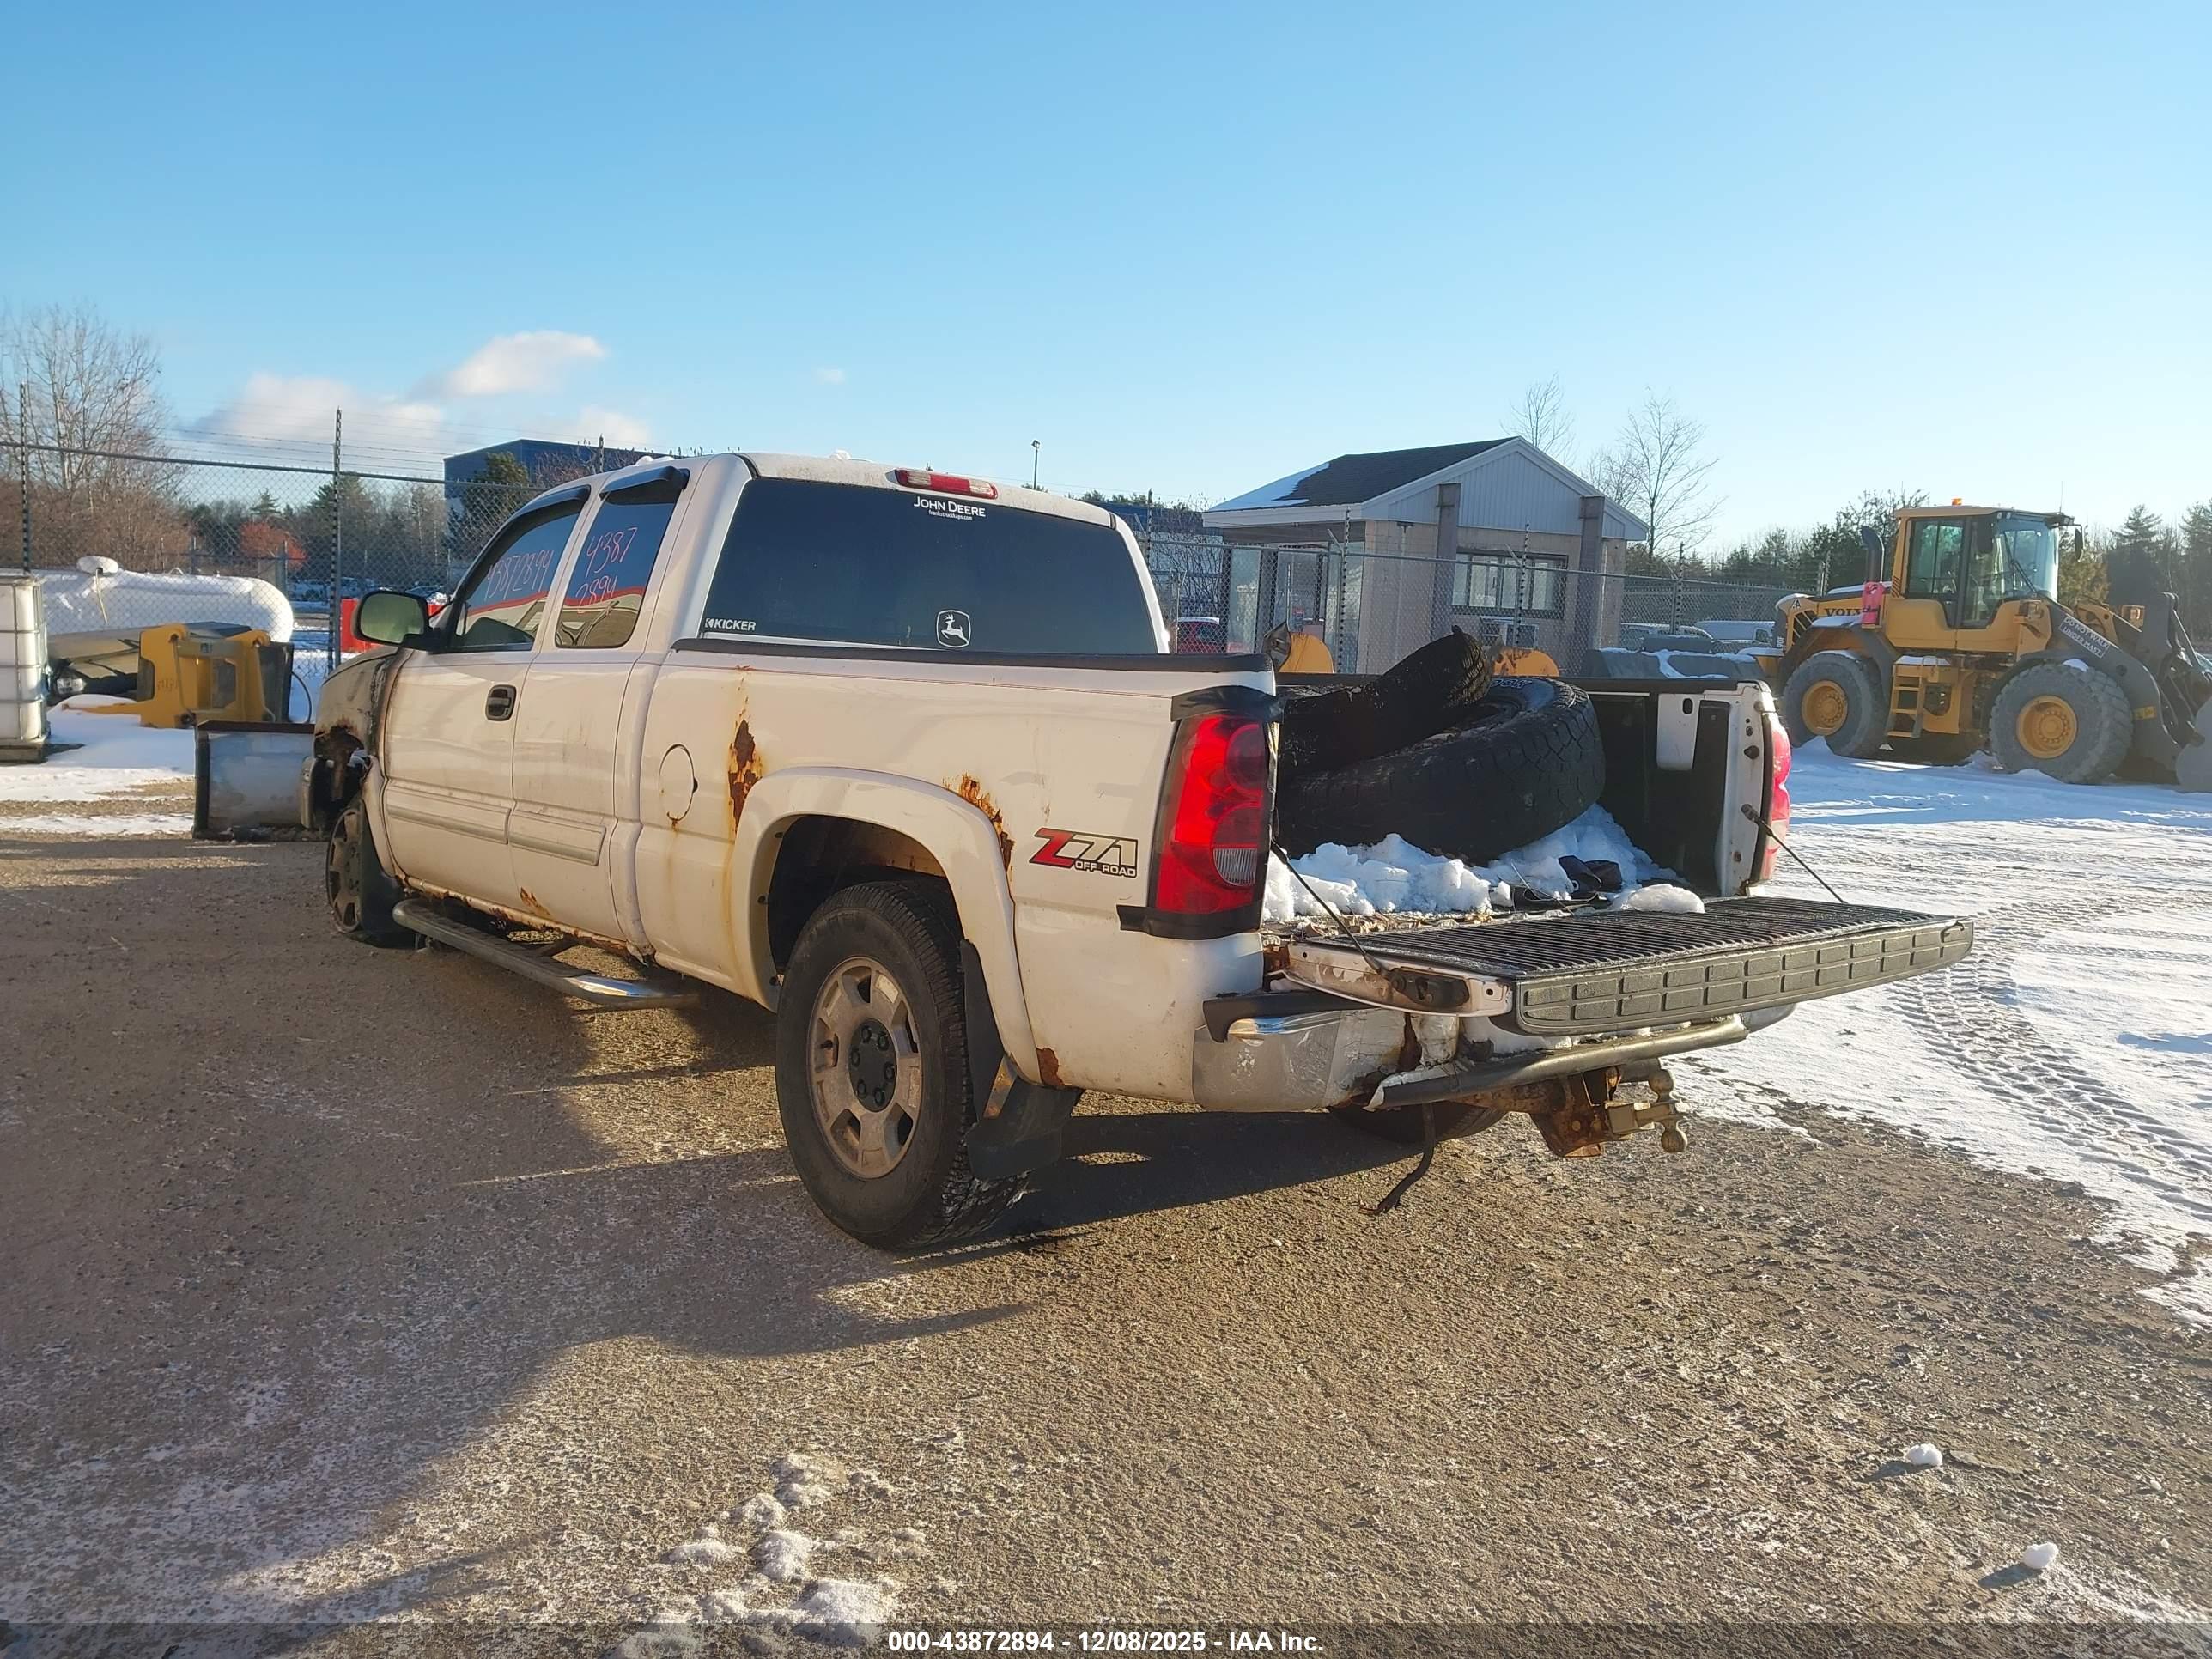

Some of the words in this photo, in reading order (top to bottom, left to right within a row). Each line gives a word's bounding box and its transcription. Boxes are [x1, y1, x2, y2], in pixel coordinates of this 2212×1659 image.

[914, 496, 945, 511] JOHN
[948, 501, 986, 517] DEERE
[585, 526, 638, 580] 4387
[574, 575, 618, 614] 2894
[714, 618, 757, 631] KICKER
[1029, 827, 1139, 869] Z71
[1074, 860, 1098, 872] OFF
[1102, 864, 1137, 877] ROAD
